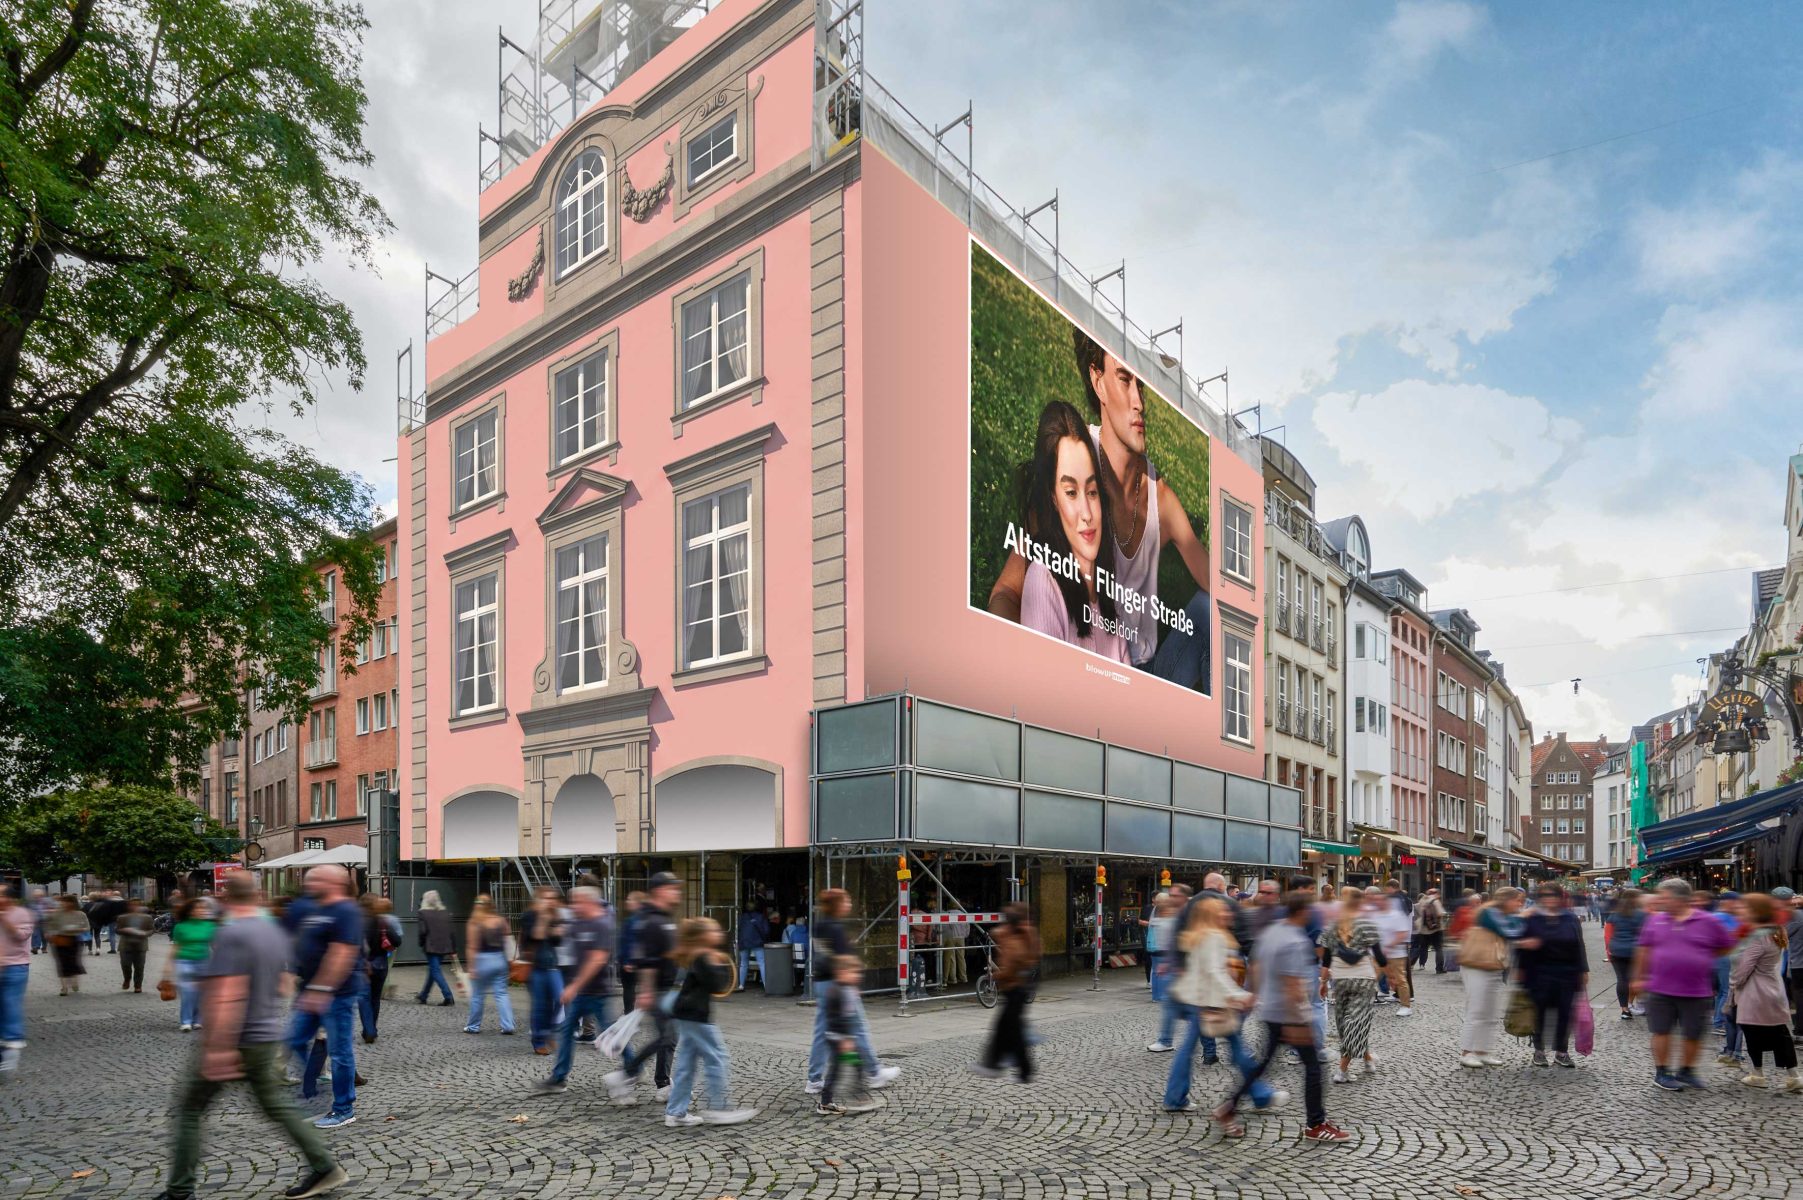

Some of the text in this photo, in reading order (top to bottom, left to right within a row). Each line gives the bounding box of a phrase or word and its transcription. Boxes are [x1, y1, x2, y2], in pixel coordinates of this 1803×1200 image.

[1003, 521, 1194, 636] Altstadt - Flinger Straße
[1083, 604, 1139, 644] Düsseldorf
